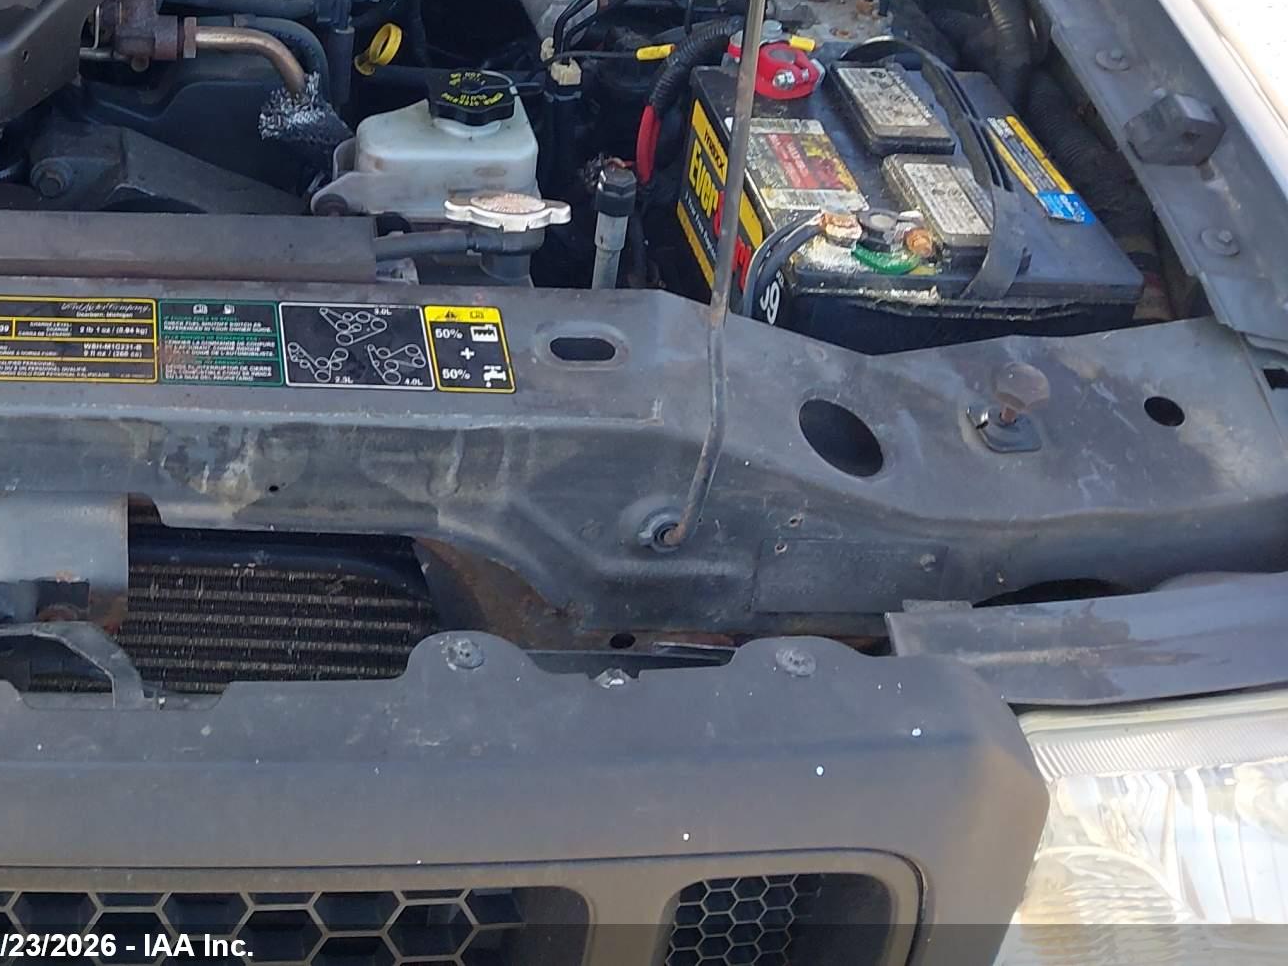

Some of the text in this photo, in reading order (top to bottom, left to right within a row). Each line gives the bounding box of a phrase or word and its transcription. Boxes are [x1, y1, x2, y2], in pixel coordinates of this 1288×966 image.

[435, 328, 463, 339] 50%
[441, 369, 471, 380] 50%
[404, 378, 423, 386] 4.0L
